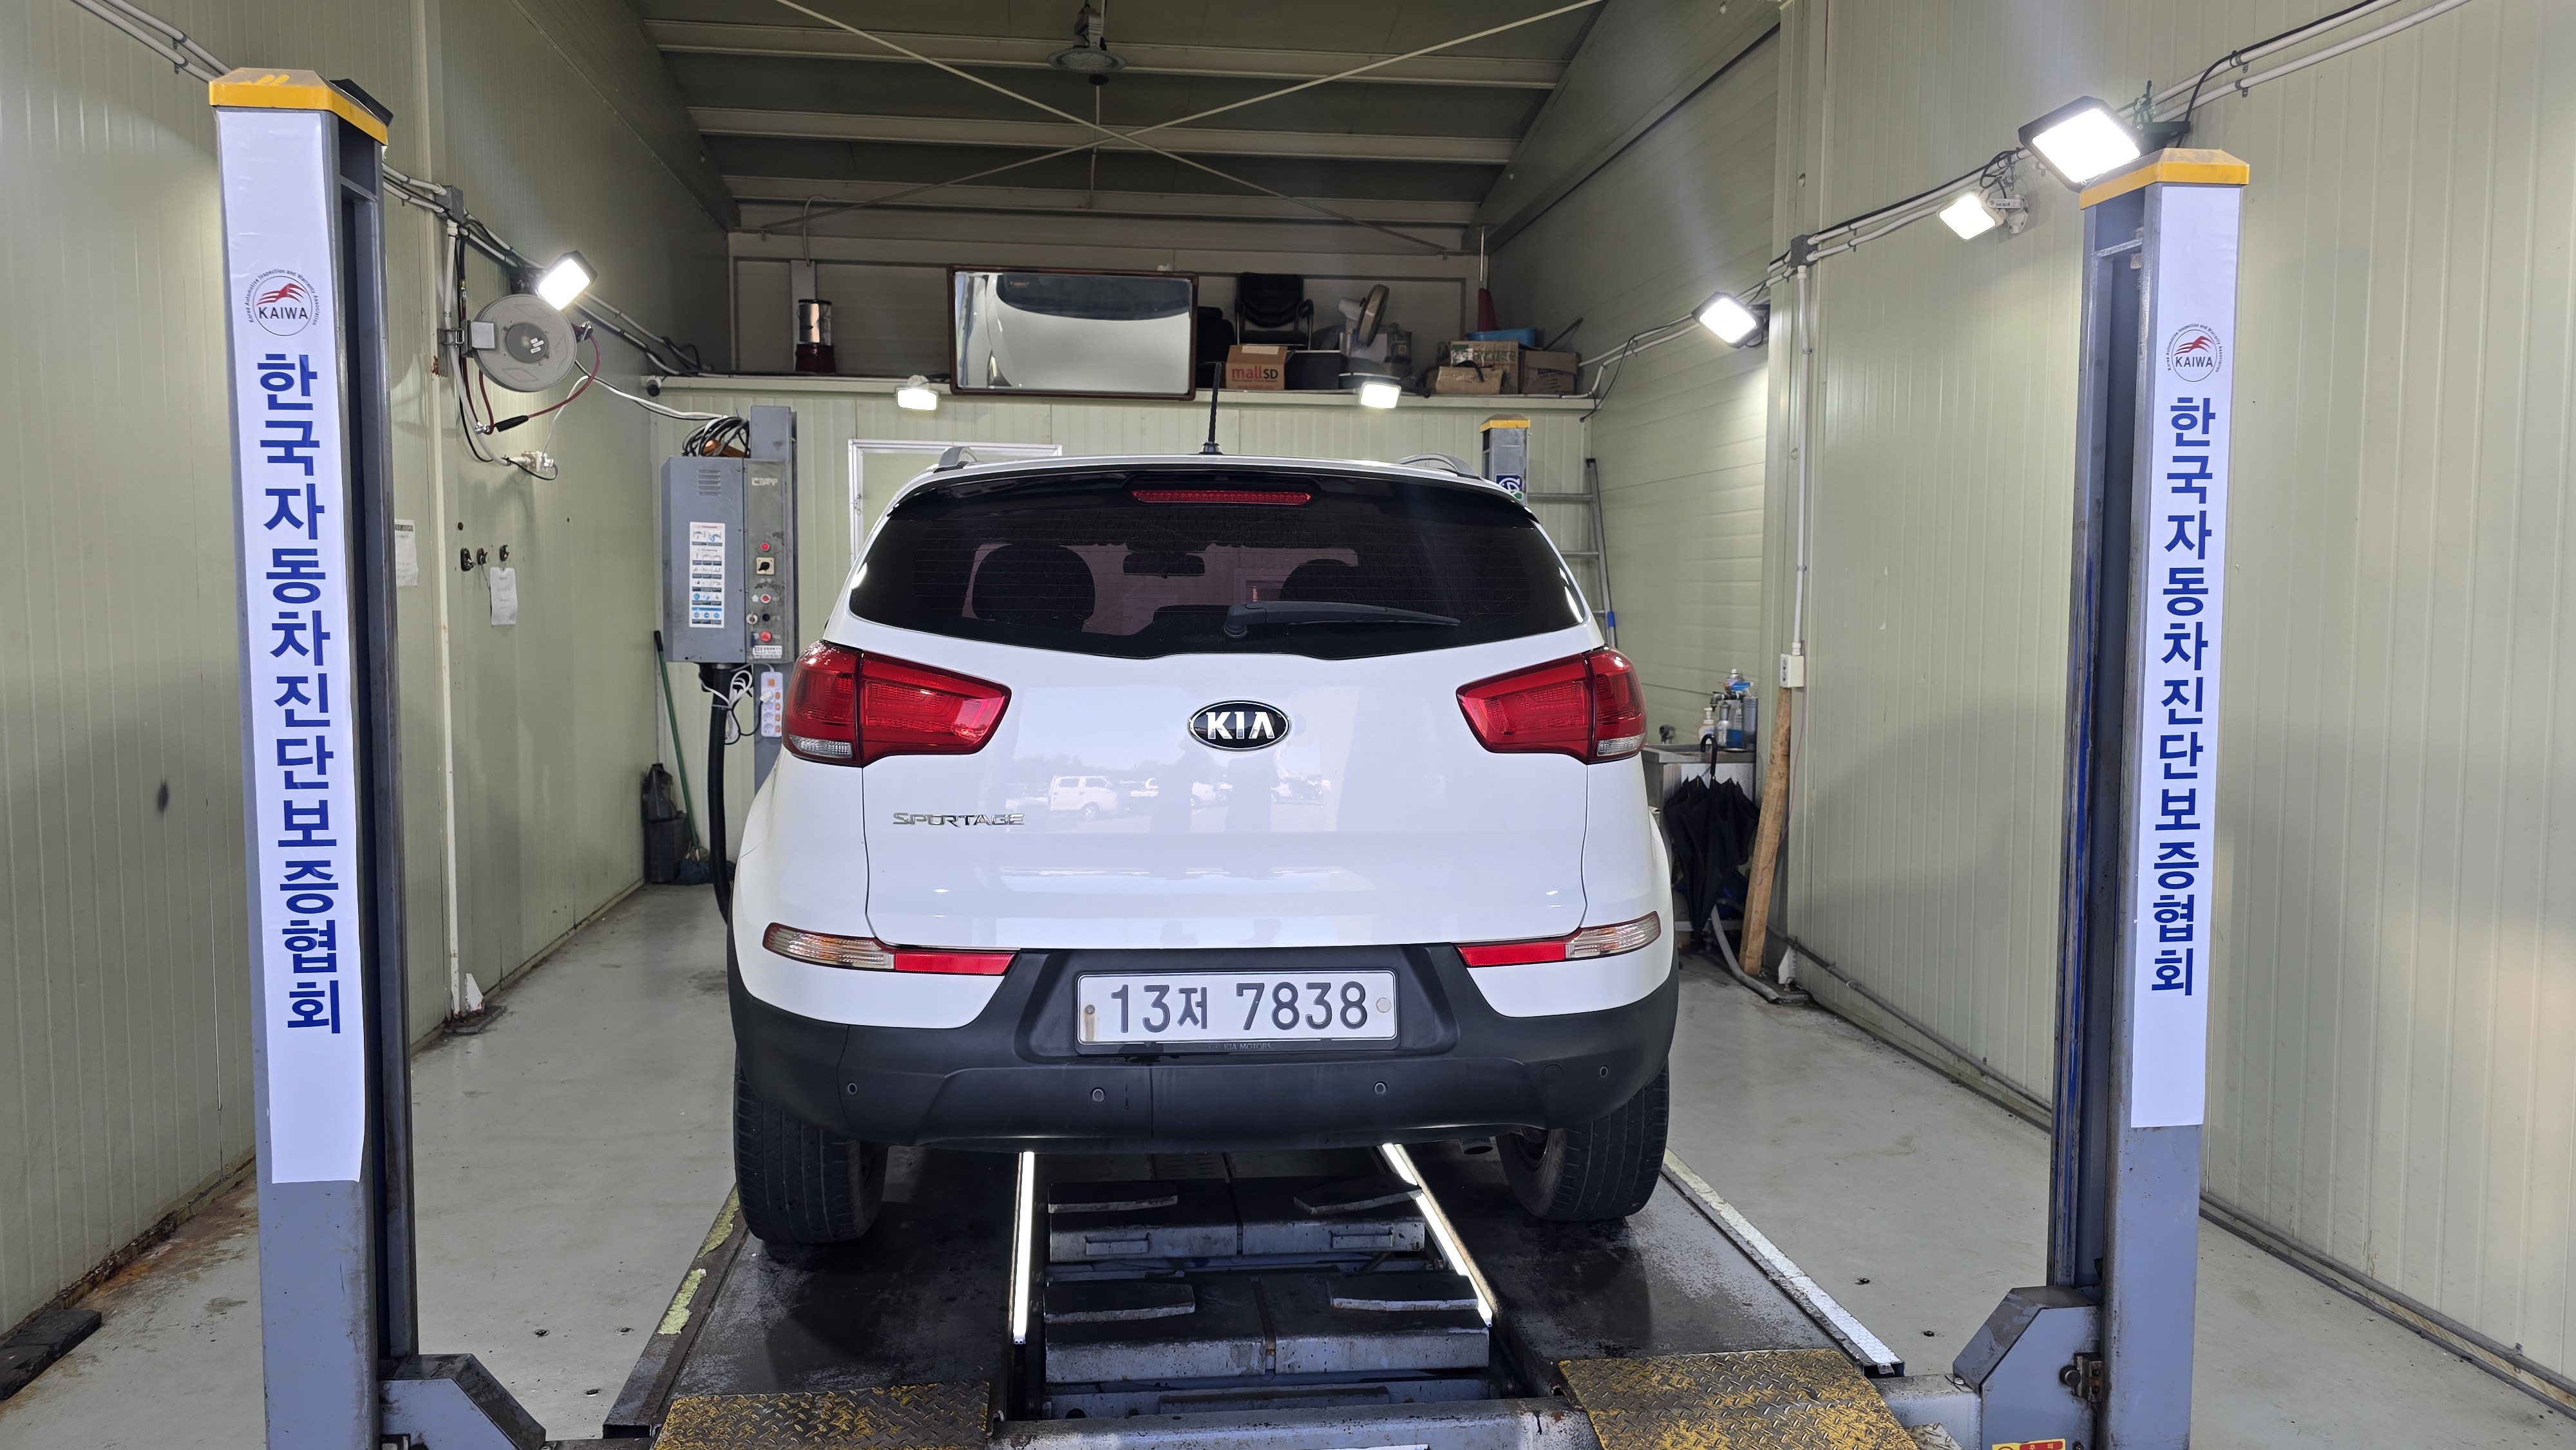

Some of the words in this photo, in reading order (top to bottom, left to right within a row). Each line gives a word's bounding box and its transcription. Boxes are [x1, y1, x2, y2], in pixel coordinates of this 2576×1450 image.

[245, 278, 260, 306] Automotive
[258, 268, 285, 280] Inspection
[297, 273, 316, 294] Warranty
[312, 295, 321, 326] Association
[258, 306, 308, 319] KAIWA
[2177, 323, 2199, 333] Inspection
[2175, 356, 2213, 368] KAIWA
[258, 353, 341, 1033] 한국자동차진단보증협회
[2151, 397, 2216, 996] 한국자동차진단보증협회
[1206, 711, 1275, 739] KIA
[893, 812, 1025, 828] SPORTAGE
[1110, 984, 1208, 1033] 13저
[1235, 981, 1368, 1031] 7838
